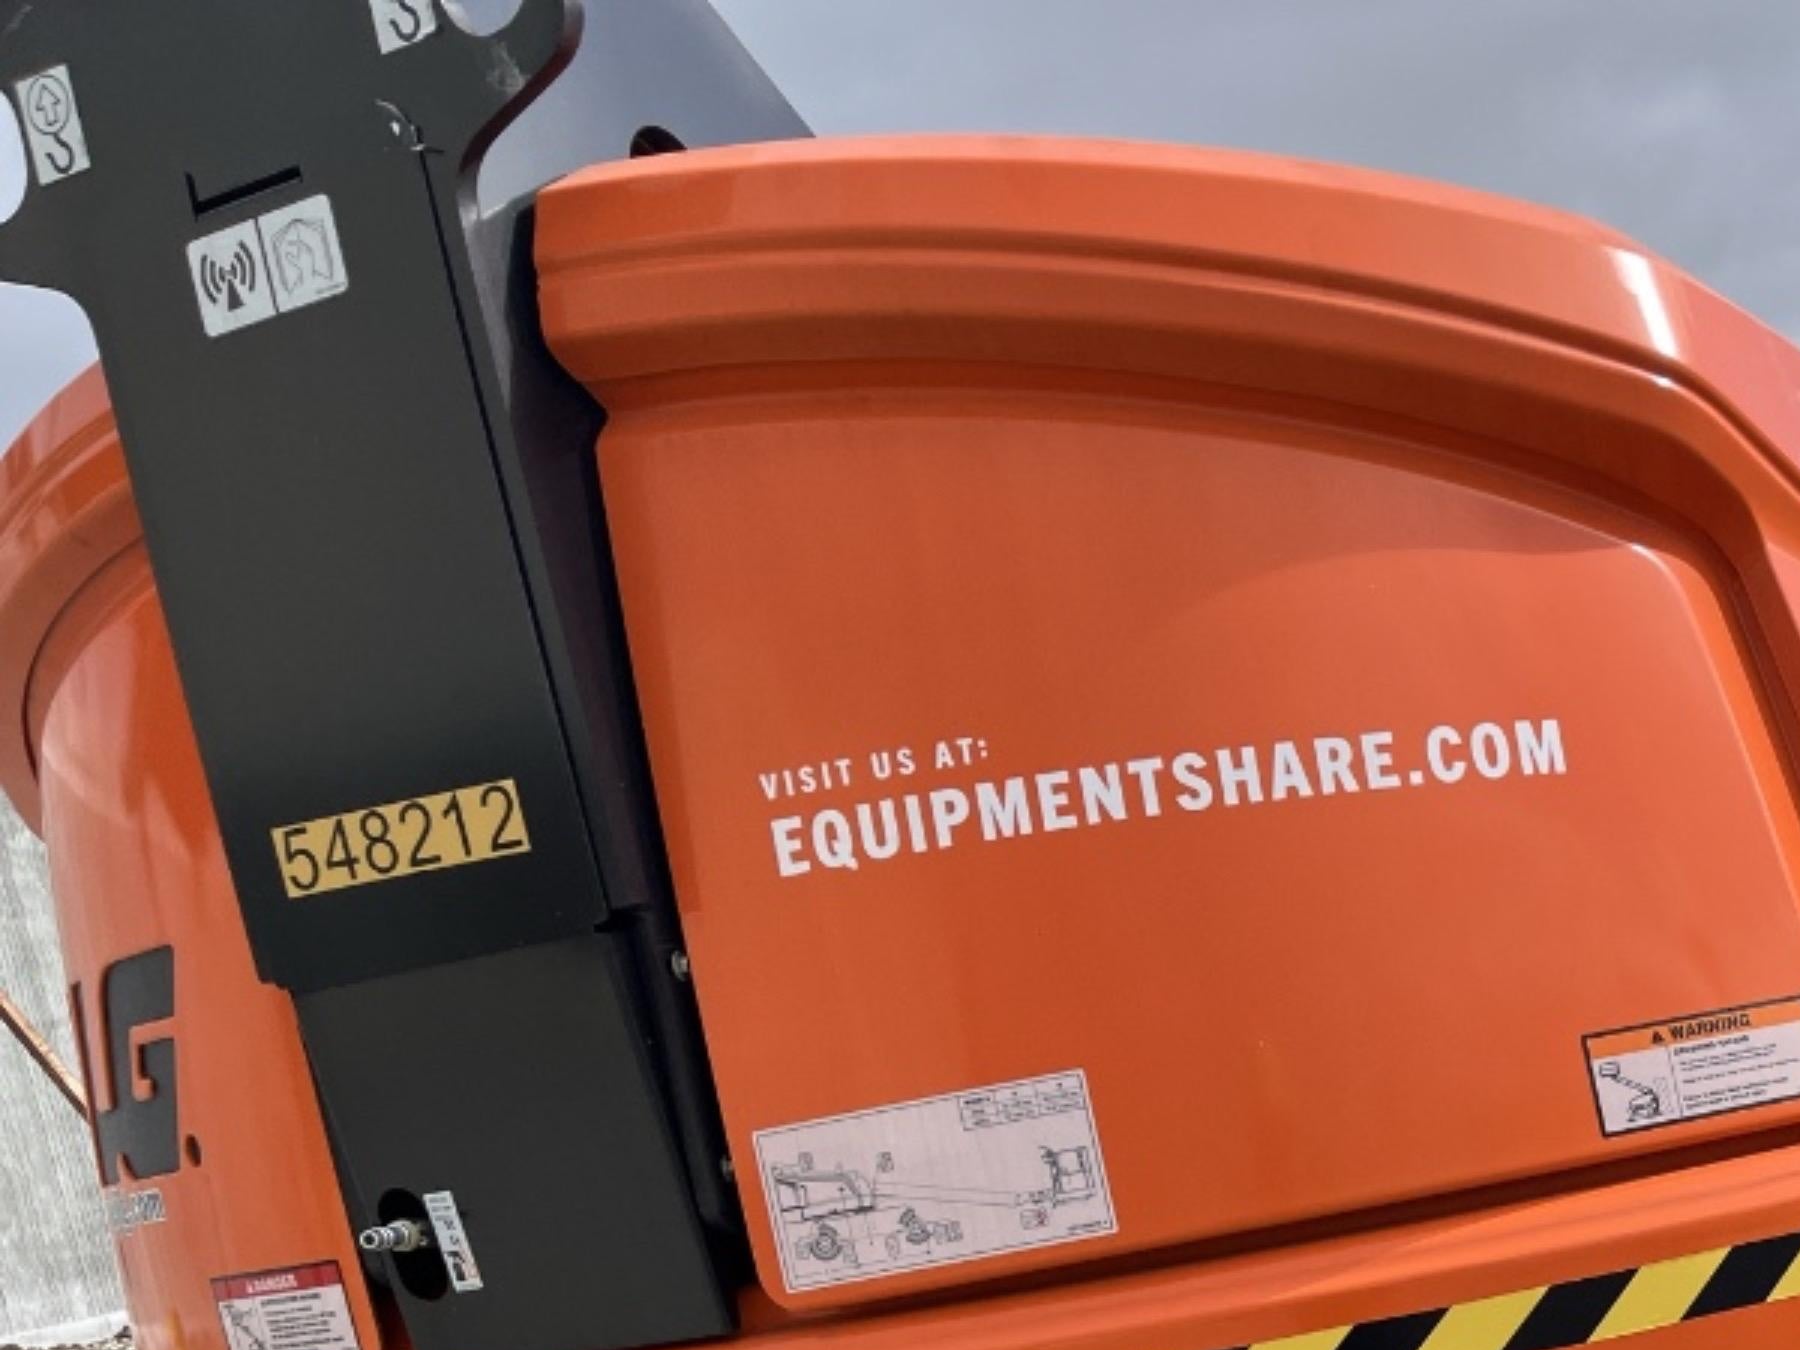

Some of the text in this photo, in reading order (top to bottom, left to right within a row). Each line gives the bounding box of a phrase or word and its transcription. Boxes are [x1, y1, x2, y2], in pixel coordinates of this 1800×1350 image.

[758, 736, 988, 801] VISIT US AT:
[770, 718, 1568, 877] EQUIPMENTSHARE.COM
[282, 785, 524, 891] 548212
[1669, 1013, 1750, 1041] WARNING
